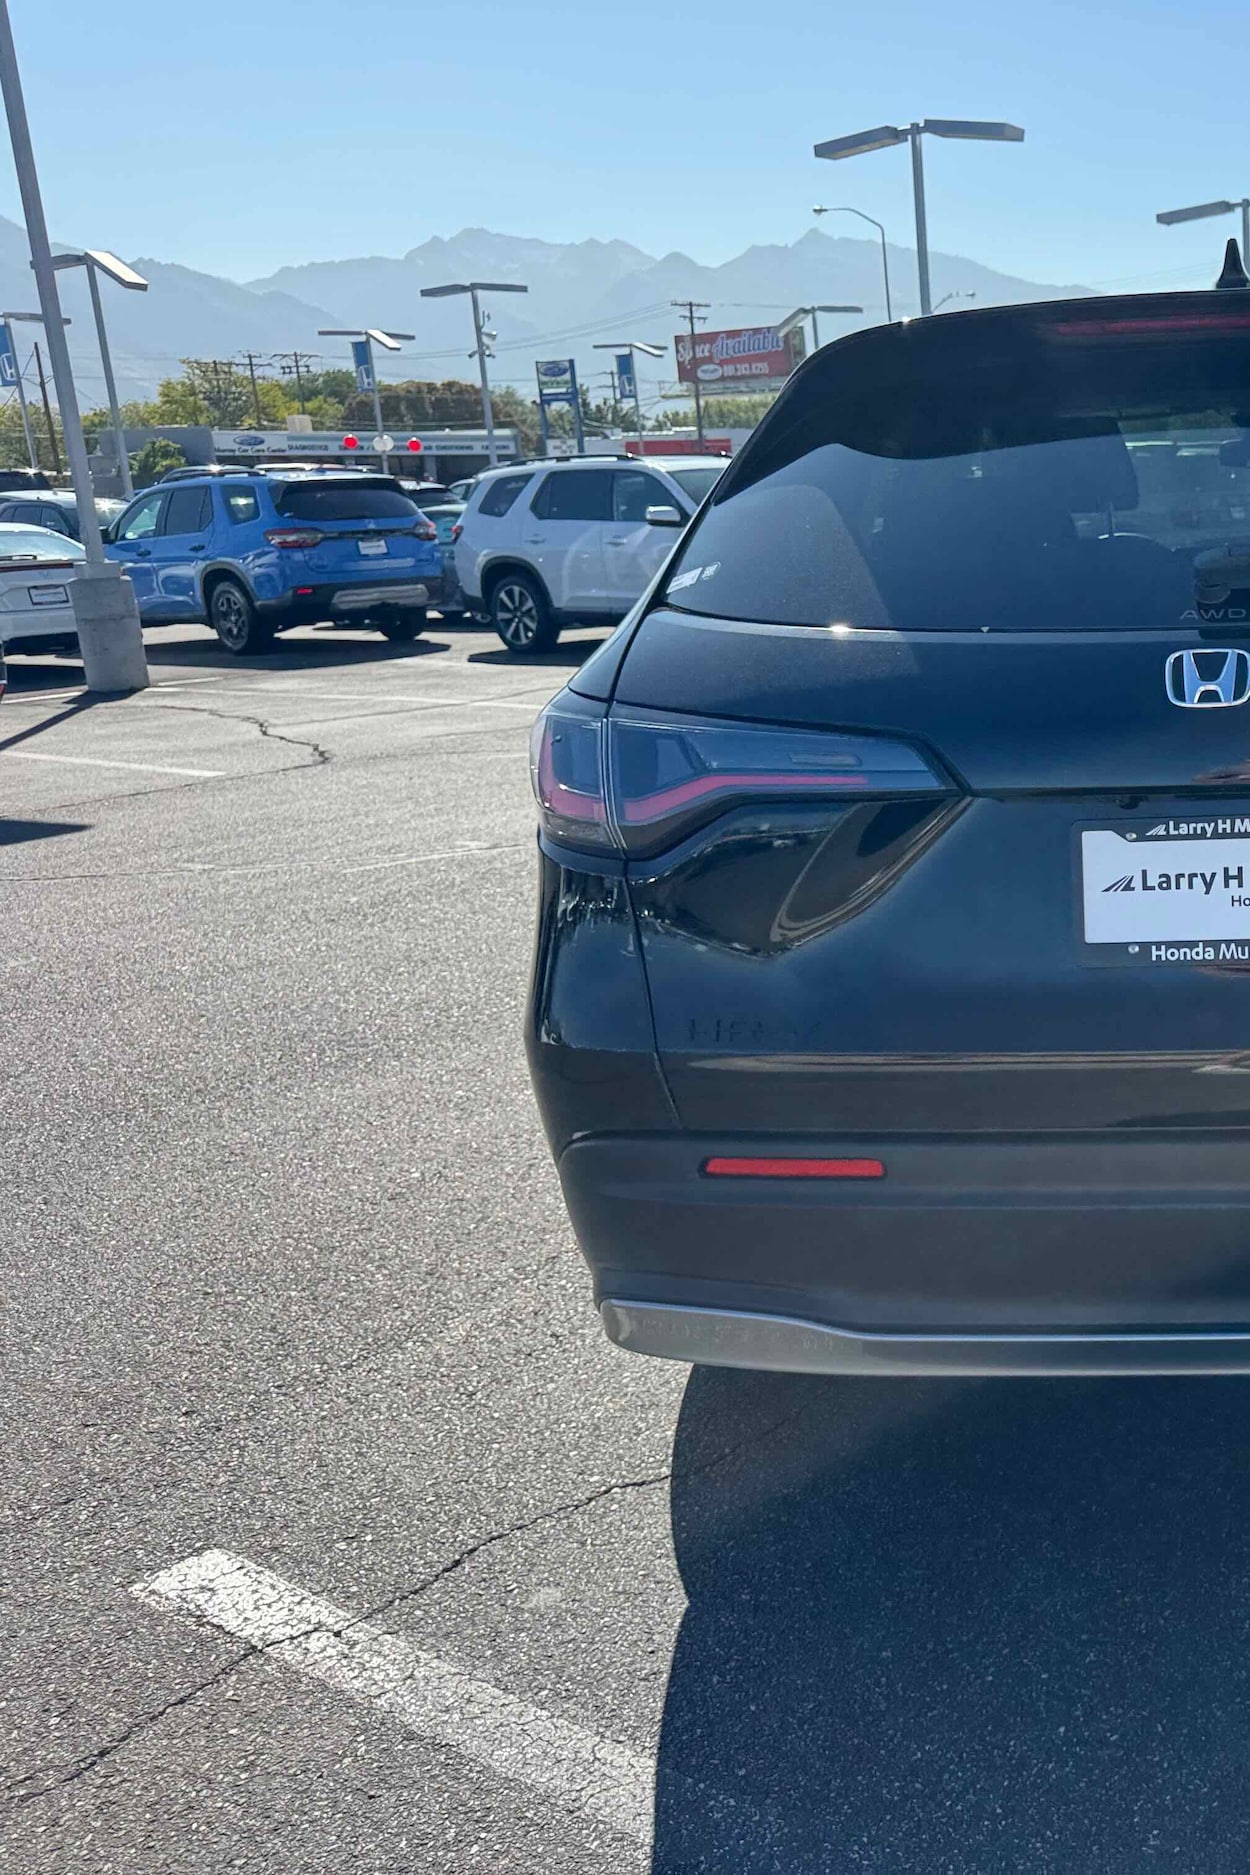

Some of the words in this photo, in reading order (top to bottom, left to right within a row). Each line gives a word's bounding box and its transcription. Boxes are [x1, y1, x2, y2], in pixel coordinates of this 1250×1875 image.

[1180, 608, 1248, 620] AWD
[1168, 820, 1215, 838] Larry
[1218, 818, 1233, 834] H
[1141, 869, 1217, 895] Larry
[1223, 866, 1244, 889] H
[1151, 943, 1215, 962] Honda
